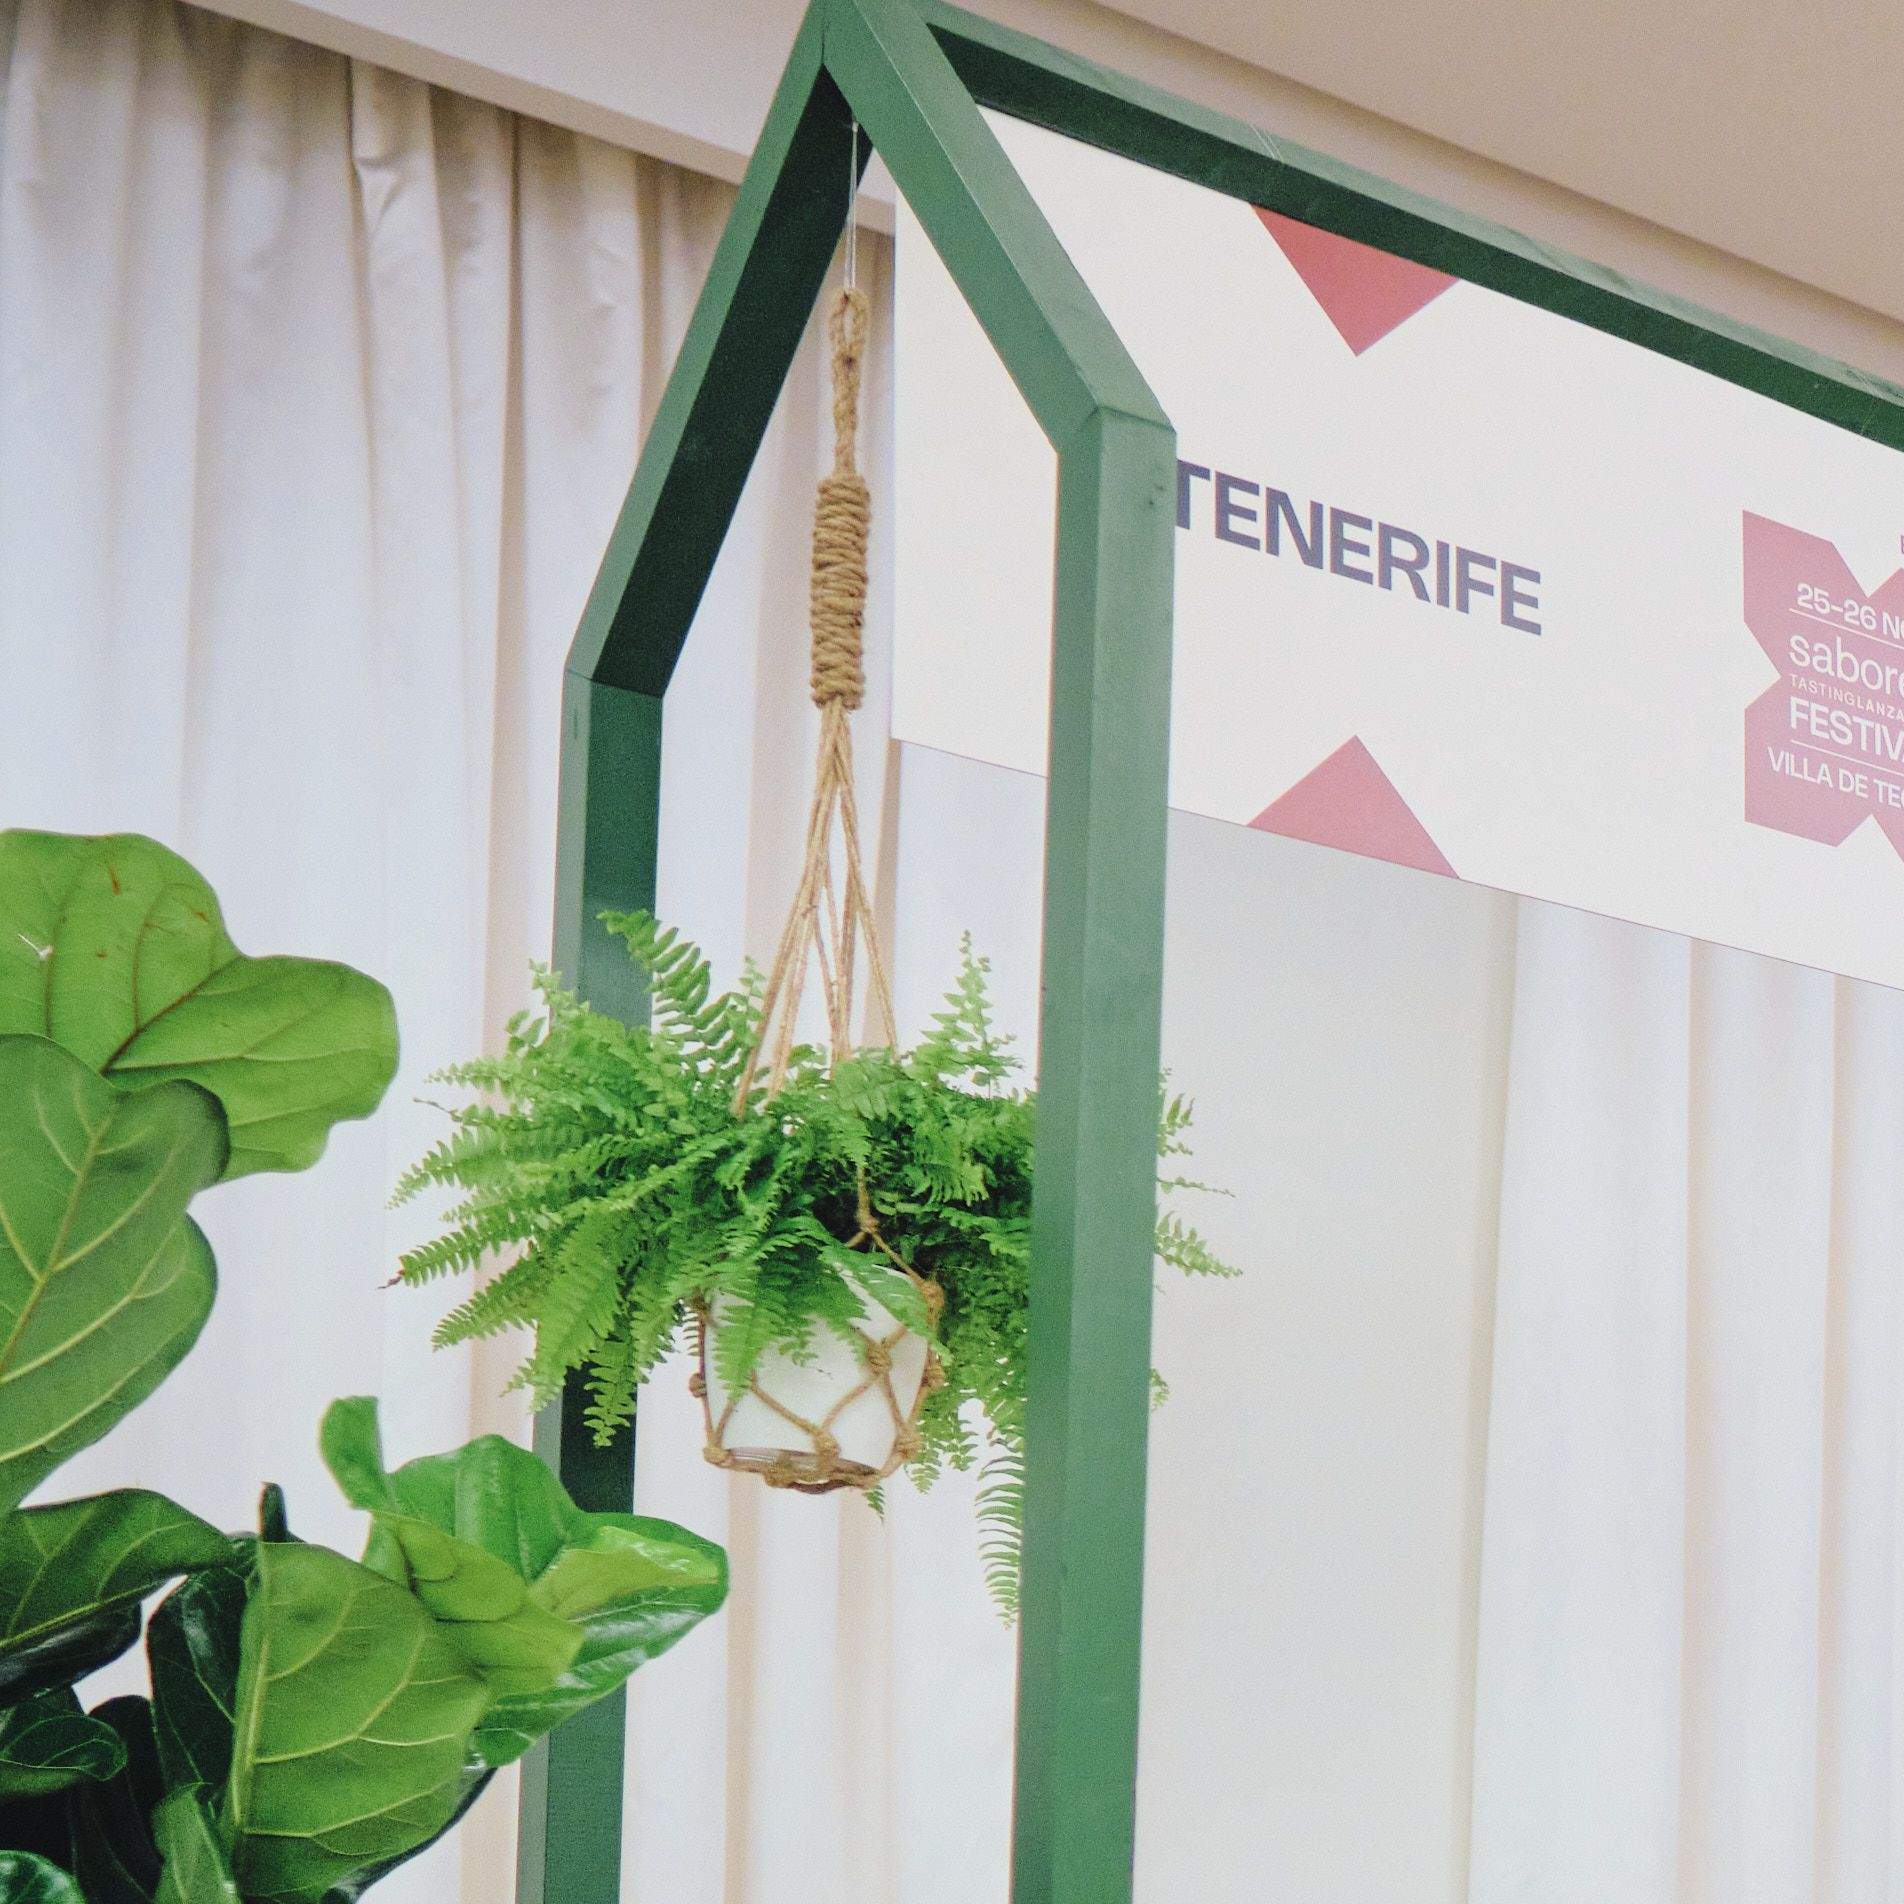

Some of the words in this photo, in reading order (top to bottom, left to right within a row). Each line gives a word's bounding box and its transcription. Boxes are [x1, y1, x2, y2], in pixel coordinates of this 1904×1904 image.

[1177, 458, 1543, 636] TENERIFE
[1796, 582, 1877, 631] 25-26
[1766, 745, 1835, 789] VILLA
[1838, 766, 1869, 799] DE
